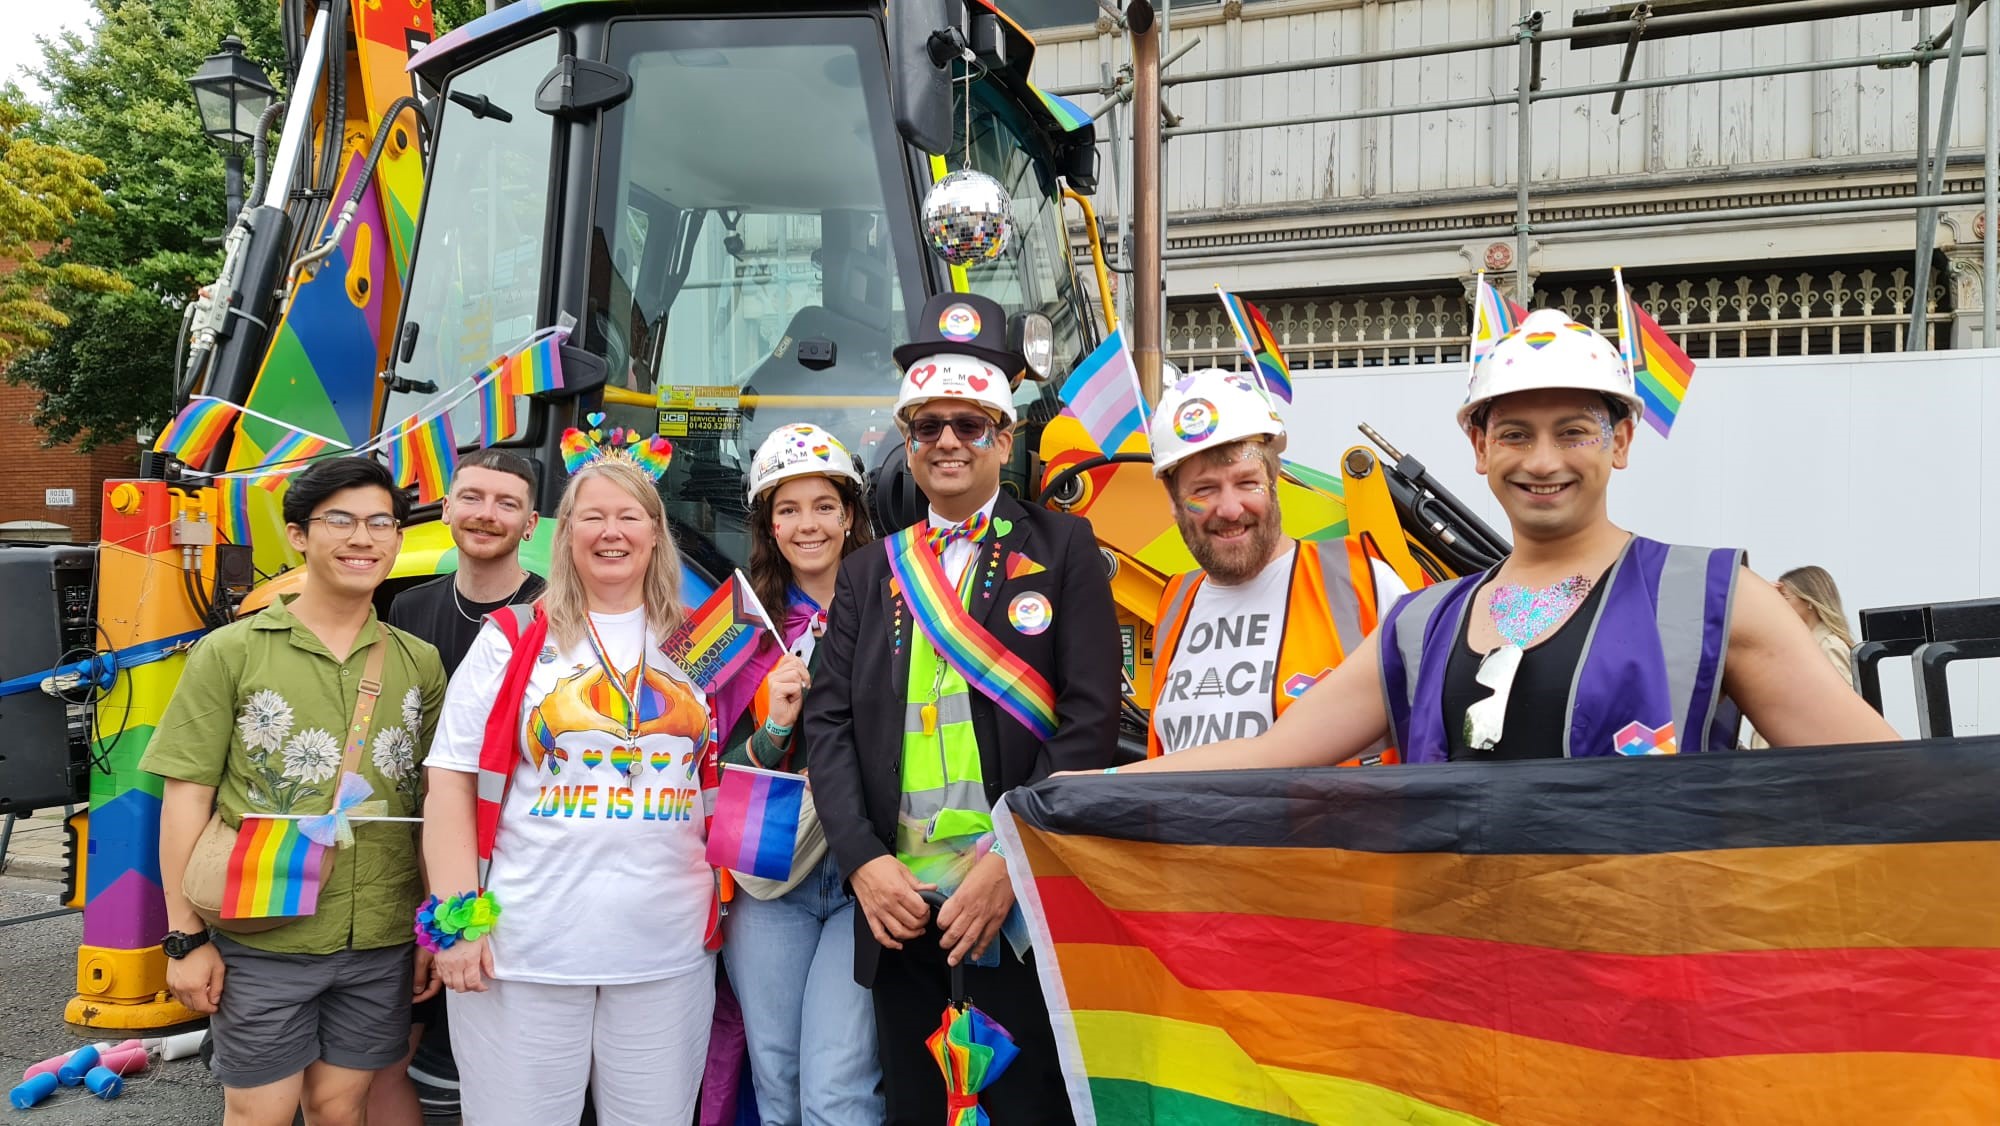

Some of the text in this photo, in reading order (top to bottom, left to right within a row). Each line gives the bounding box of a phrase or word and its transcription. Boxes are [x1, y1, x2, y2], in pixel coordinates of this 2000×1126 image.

[661, 414, 686, 422] JCB
[1187, 614, 1270, 654] ONE
[1162, 711, 1269, 752] MIND
[529, 785, 697, 821] LOVE IS LOVE
